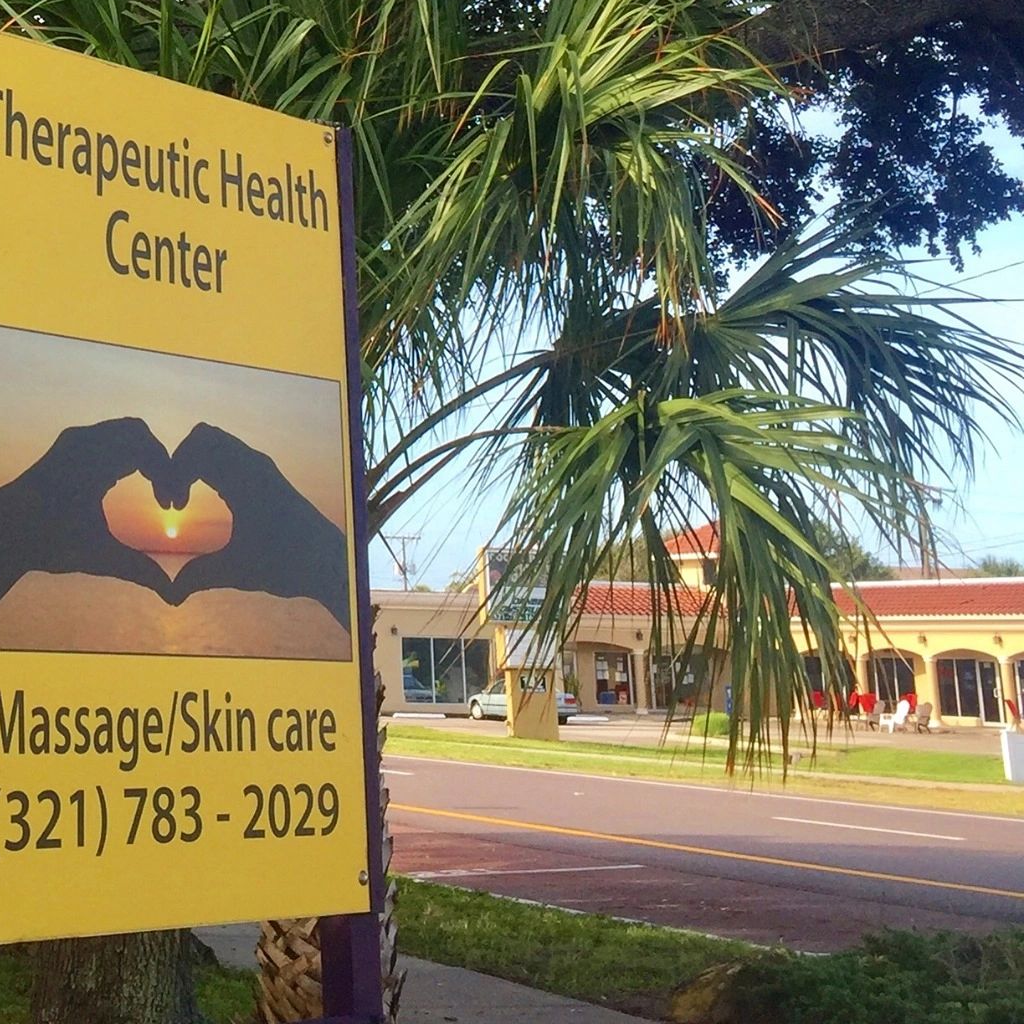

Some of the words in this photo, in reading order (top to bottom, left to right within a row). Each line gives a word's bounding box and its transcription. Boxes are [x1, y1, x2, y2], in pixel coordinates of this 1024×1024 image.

[220, 148, 330, 233] Health
[105, 209, 228, 294] Center
[267, 708, 337, 753] care
[123, 785, 203, 845] 783
[242, 782, 340, 840] 2029
